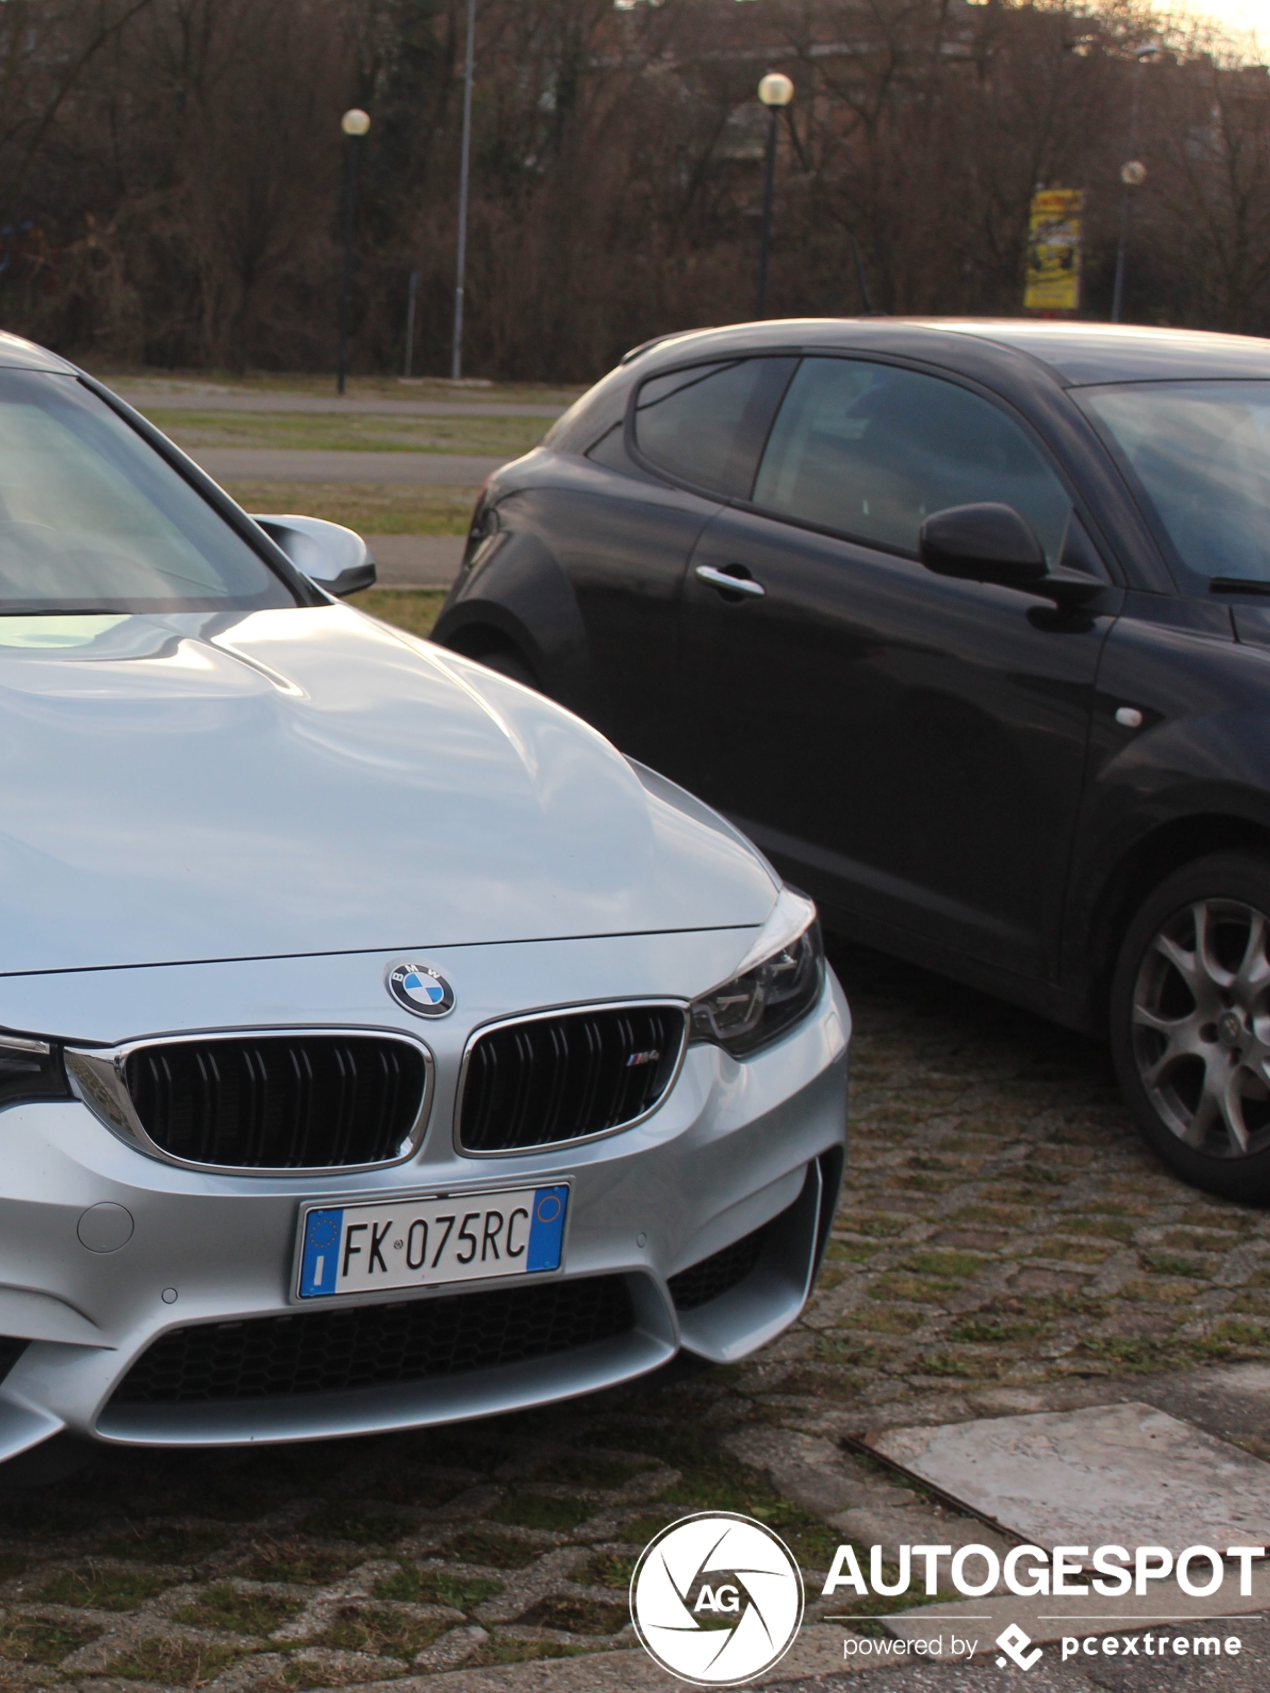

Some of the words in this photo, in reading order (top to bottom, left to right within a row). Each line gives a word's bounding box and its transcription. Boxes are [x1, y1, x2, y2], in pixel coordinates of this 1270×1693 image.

[391, 964, 441, 982] BMW
[342, 1220, 393, 1277] FK
[406, 1207, 529, 1270] 075RC
